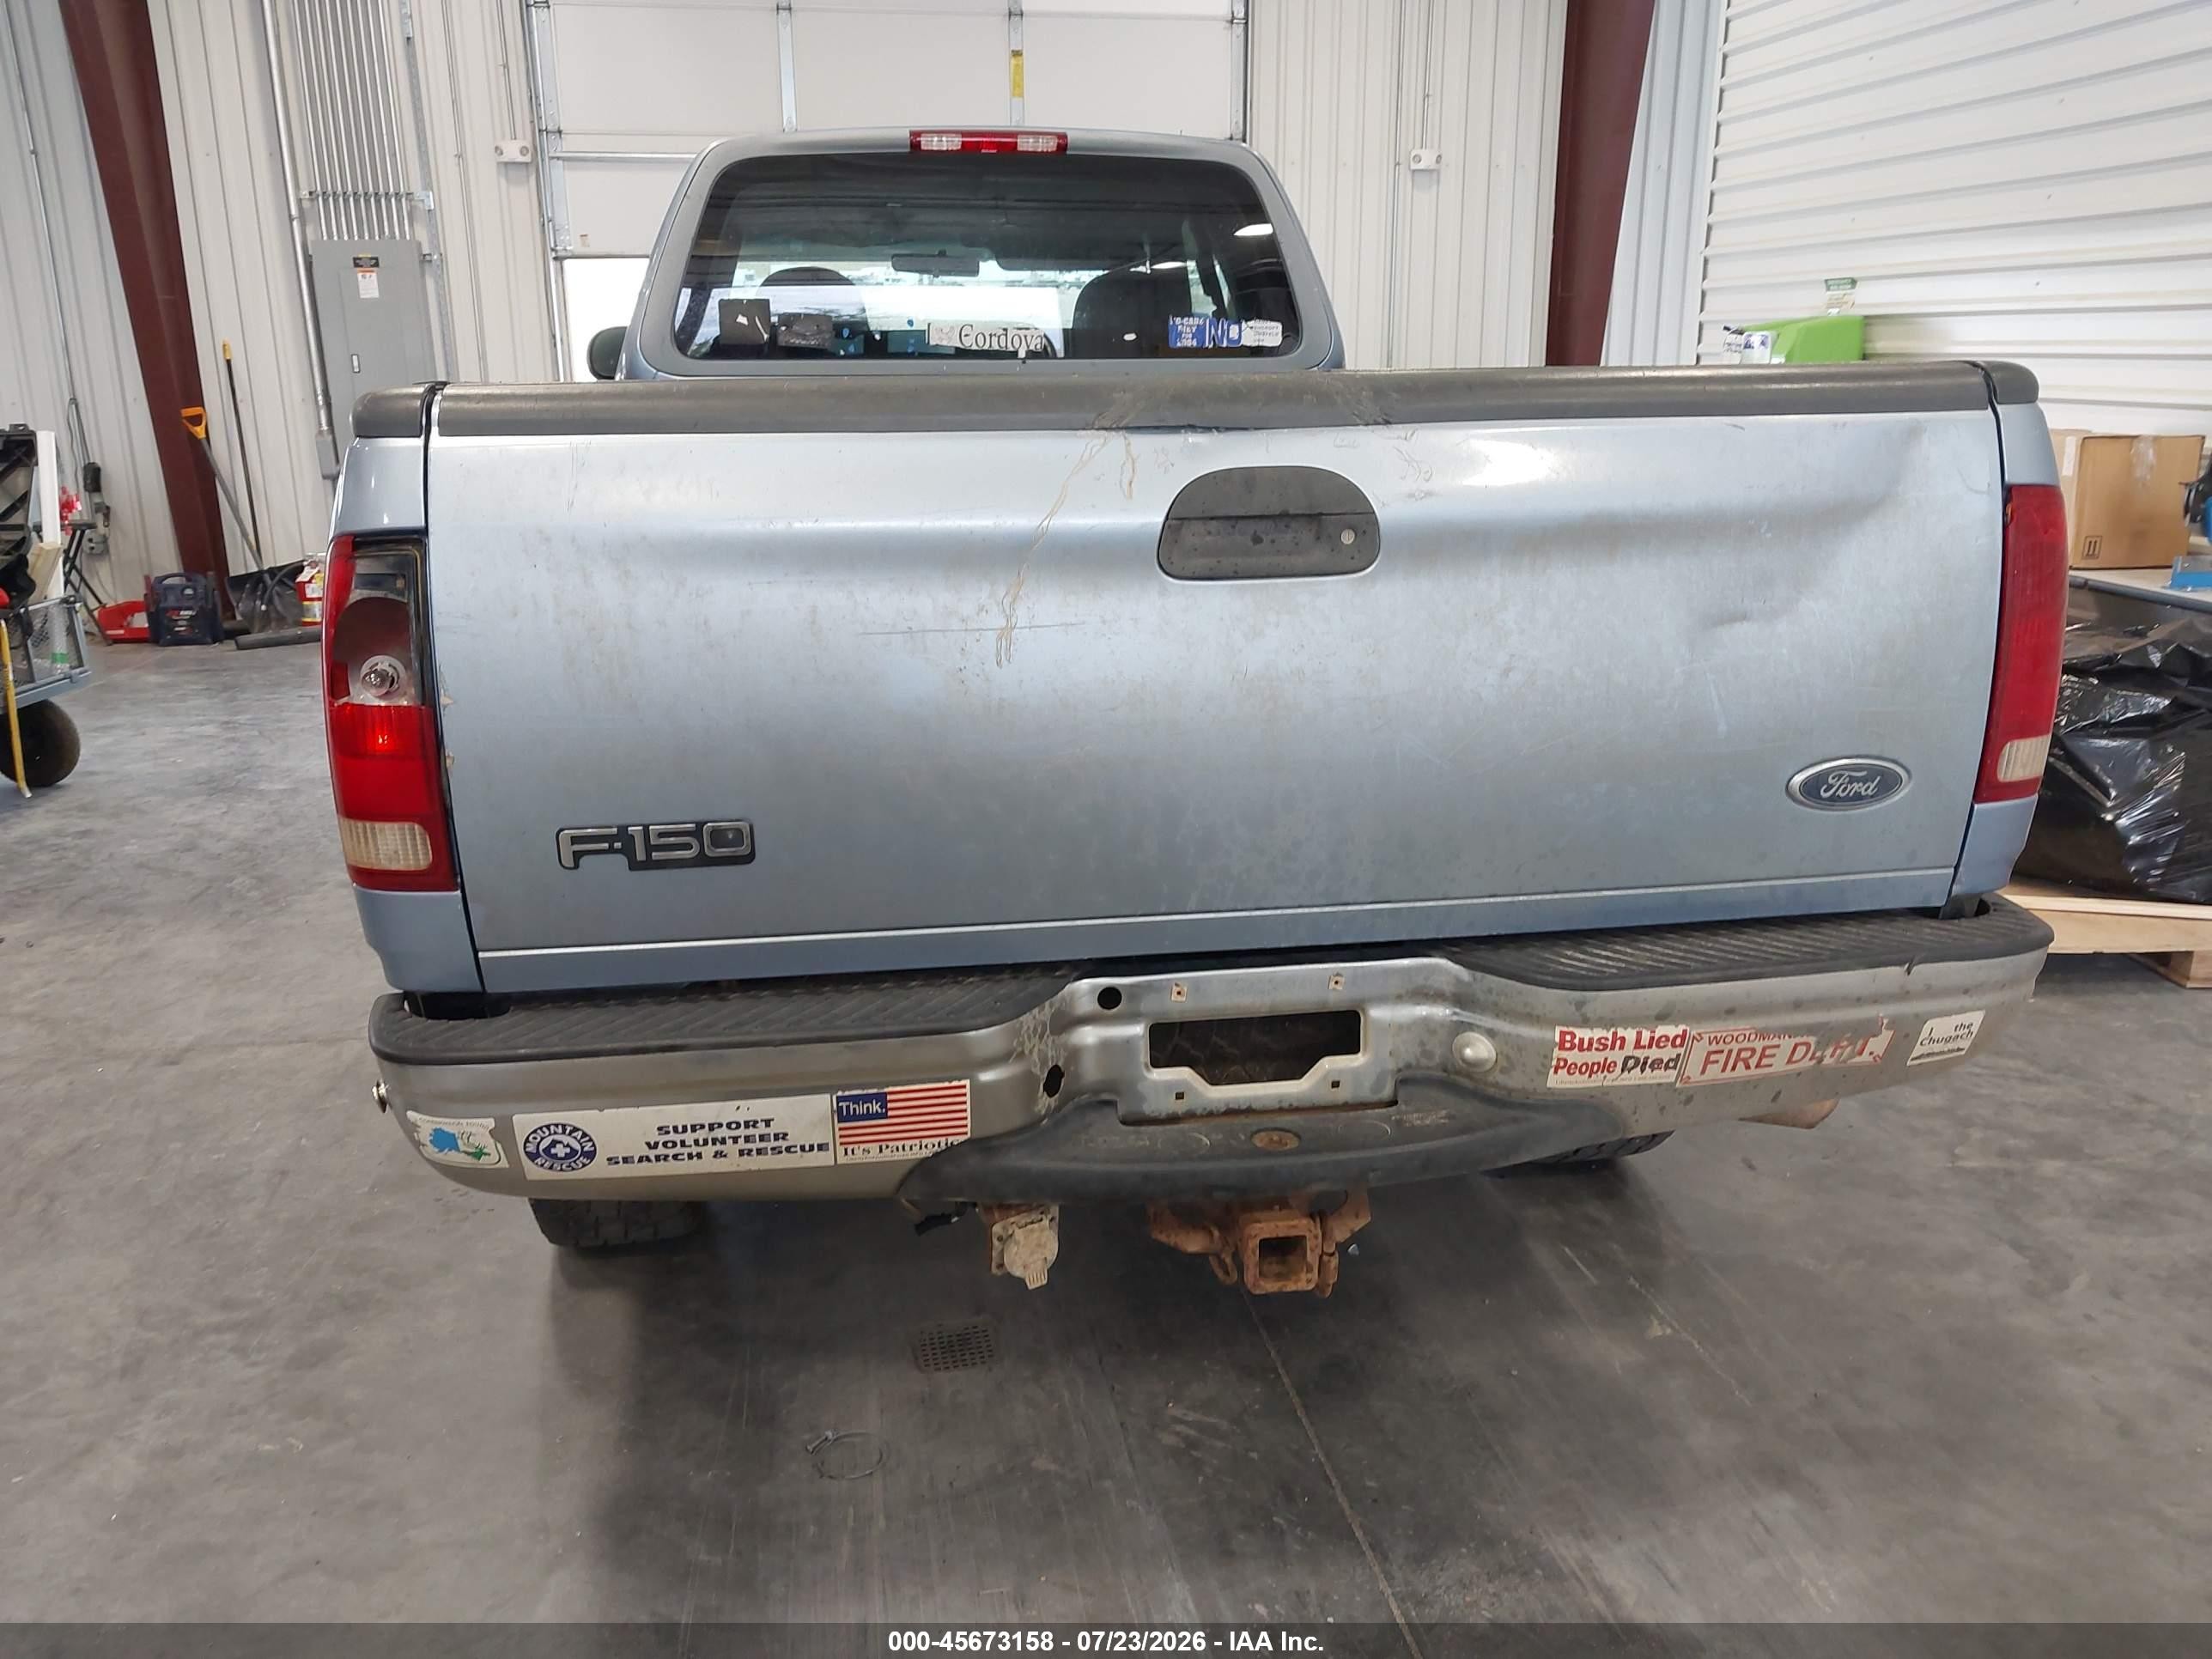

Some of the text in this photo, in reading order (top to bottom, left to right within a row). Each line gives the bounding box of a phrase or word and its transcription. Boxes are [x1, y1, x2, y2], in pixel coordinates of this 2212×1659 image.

[958, 324, 1044, 351] Cordova
[1820, 770, 1881, 799] Ford
[559, 821, 751, 867] F-150
[1954, 1021, 1973, 1032] the
[1558, 1029, 1688, 1052] Bush Lied
[1553, 1053, 1682, 1079] People Died
[1699, 1043, 1781, 1076] FIRE
[838, 1099, 886, 1117] Think.
[525, 1124, 595, 1153] MOUNTAIN
[656, 1118, 775, 1136] SUPPORT
[645, 1131, 790, 1151] VOLUNTEER
[842, 1145, 872, 1158] It's
[878, 1137, 960, 1154] Patriotic
[534, 1156, 591, 1172] RESCUE
[605, 1151, 704, 1166] SEARCH
[712, 1150, 728, 1159] &
[738, 1142, 830, 1158] RESCUE
